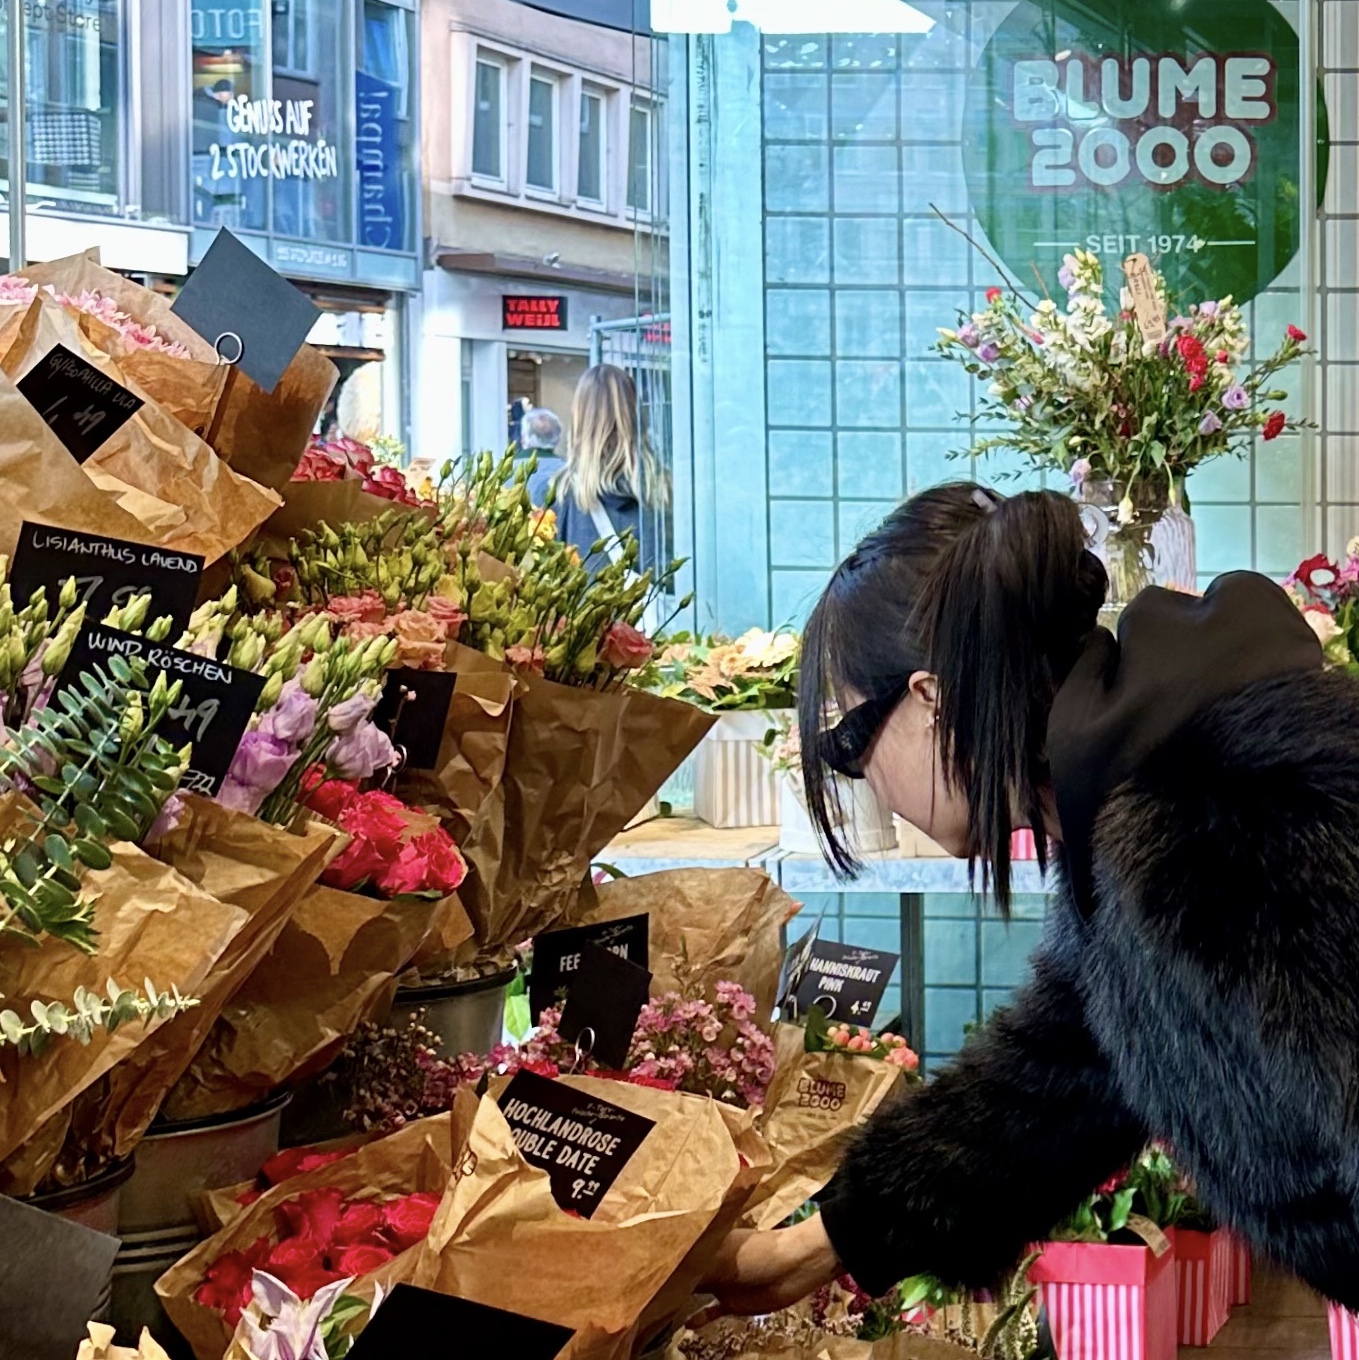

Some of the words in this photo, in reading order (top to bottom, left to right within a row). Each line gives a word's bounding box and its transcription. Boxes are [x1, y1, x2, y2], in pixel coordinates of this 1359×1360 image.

[1013, 57, 1271, 121] BLUME
[227, 94, 283, 134] GENUSS
[286, 100, 313, 135] AUF
[209, 143, 225, 180] 2
[226, 139, 337, 180] STOCKWERKEN
[1031, 125, 1252, 186] 2000
[1086, 234, 1141, 254] SEIT
[1149, 234, 1199, 254] 1974
[506, 299, 560, 312] TALLY
[32, 529, 136, 567] LISIANTHUS
[141, 550, 199, 575] LAVEND
[88, 632, 143, 656] WIND
[147, 648, 233, 684] RÖSCHEN
[809, 957, 882, 984] HANNISKRAUT
[797, 1078, 846, 1099] BLUME
[798, 1092, 842, 1111] 2000
[503, 1097, 622, 1156] HOCHLANDROSE
[511, 1127, 559, 1160] OUBLE
[555, 1145, 601, 1176] DATE
